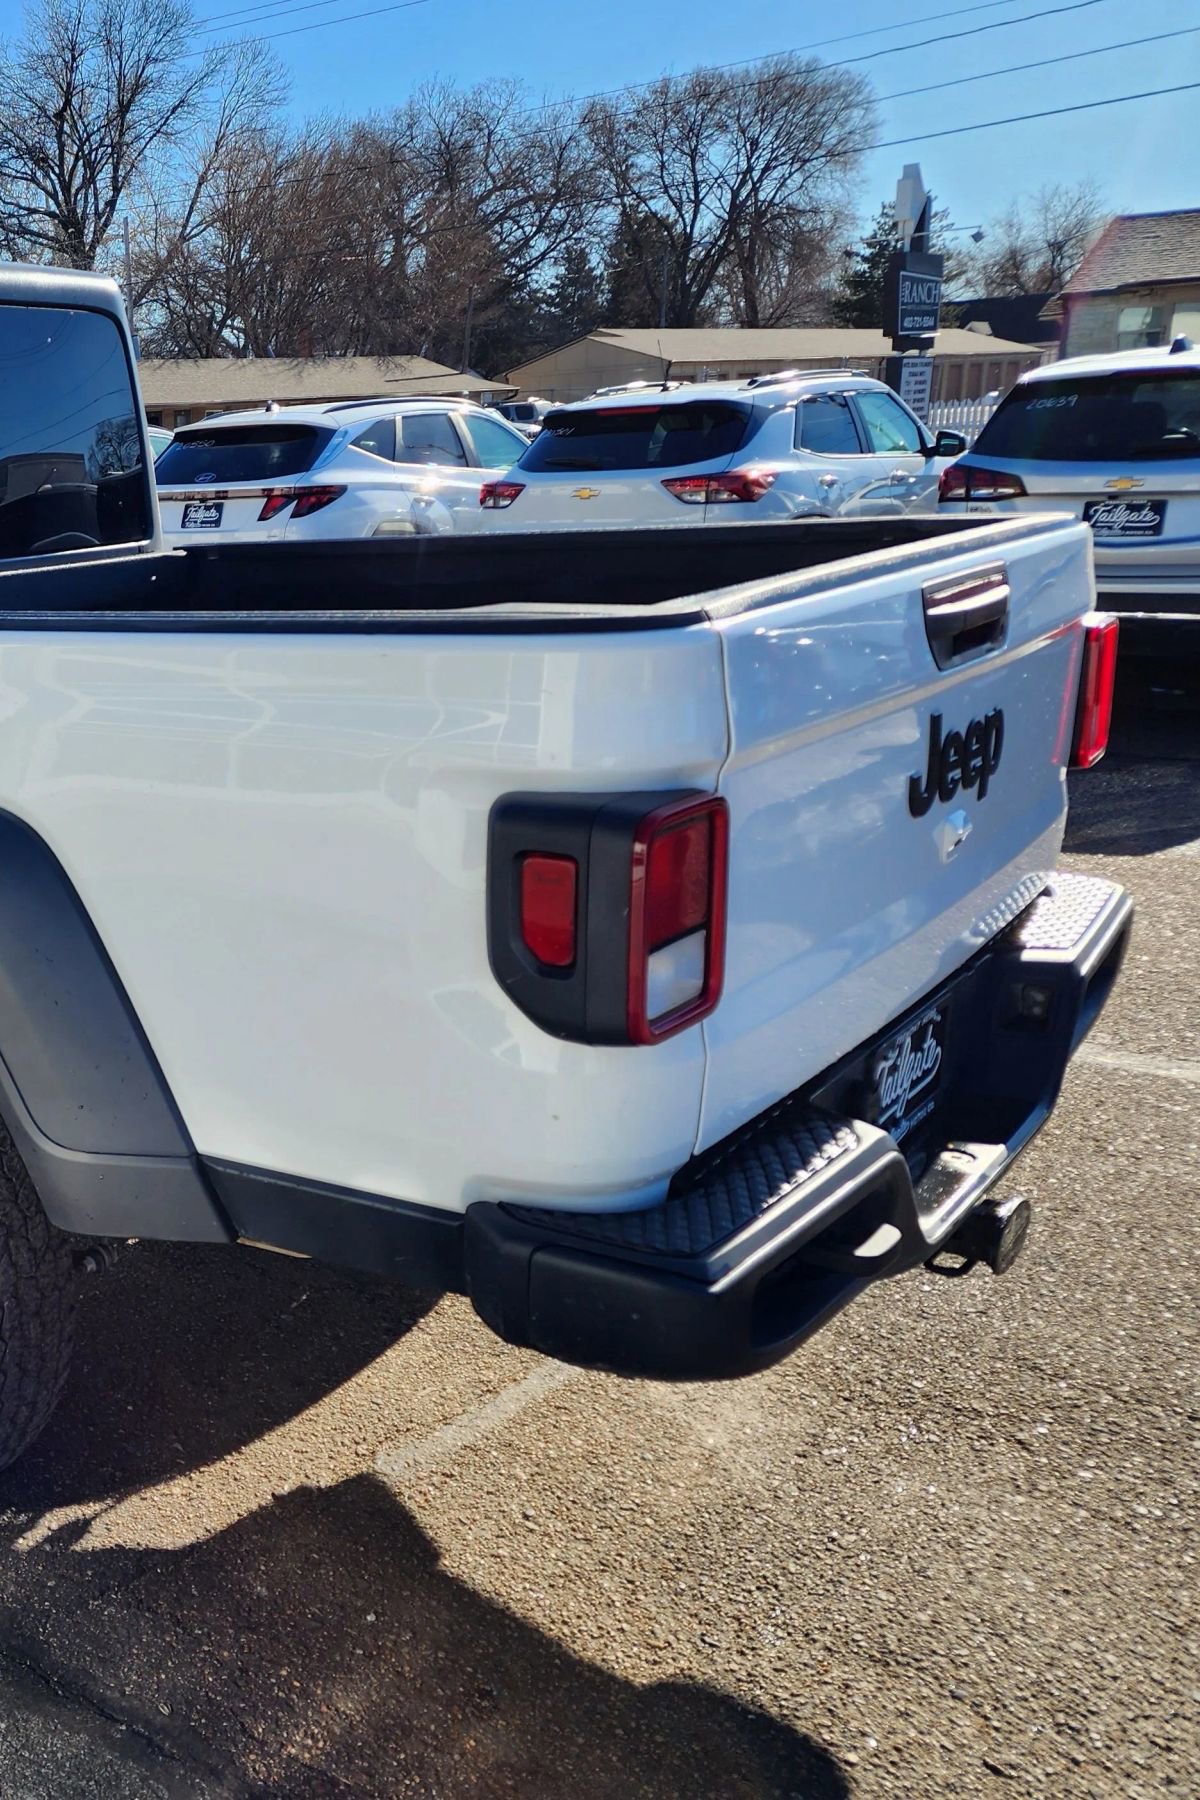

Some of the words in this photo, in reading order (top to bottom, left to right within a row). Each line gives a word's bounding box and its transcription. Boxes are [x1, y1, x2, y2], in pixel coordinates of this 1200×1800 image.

[904, 281, 940, 304] RANCH
[185, 505, 220, 522] Tailgate
[1089, 504, 1161, 529] Tailgate
[908, 707, 1004, 819] Jeep
[876, 1024, 942, 1123] Tailgate
